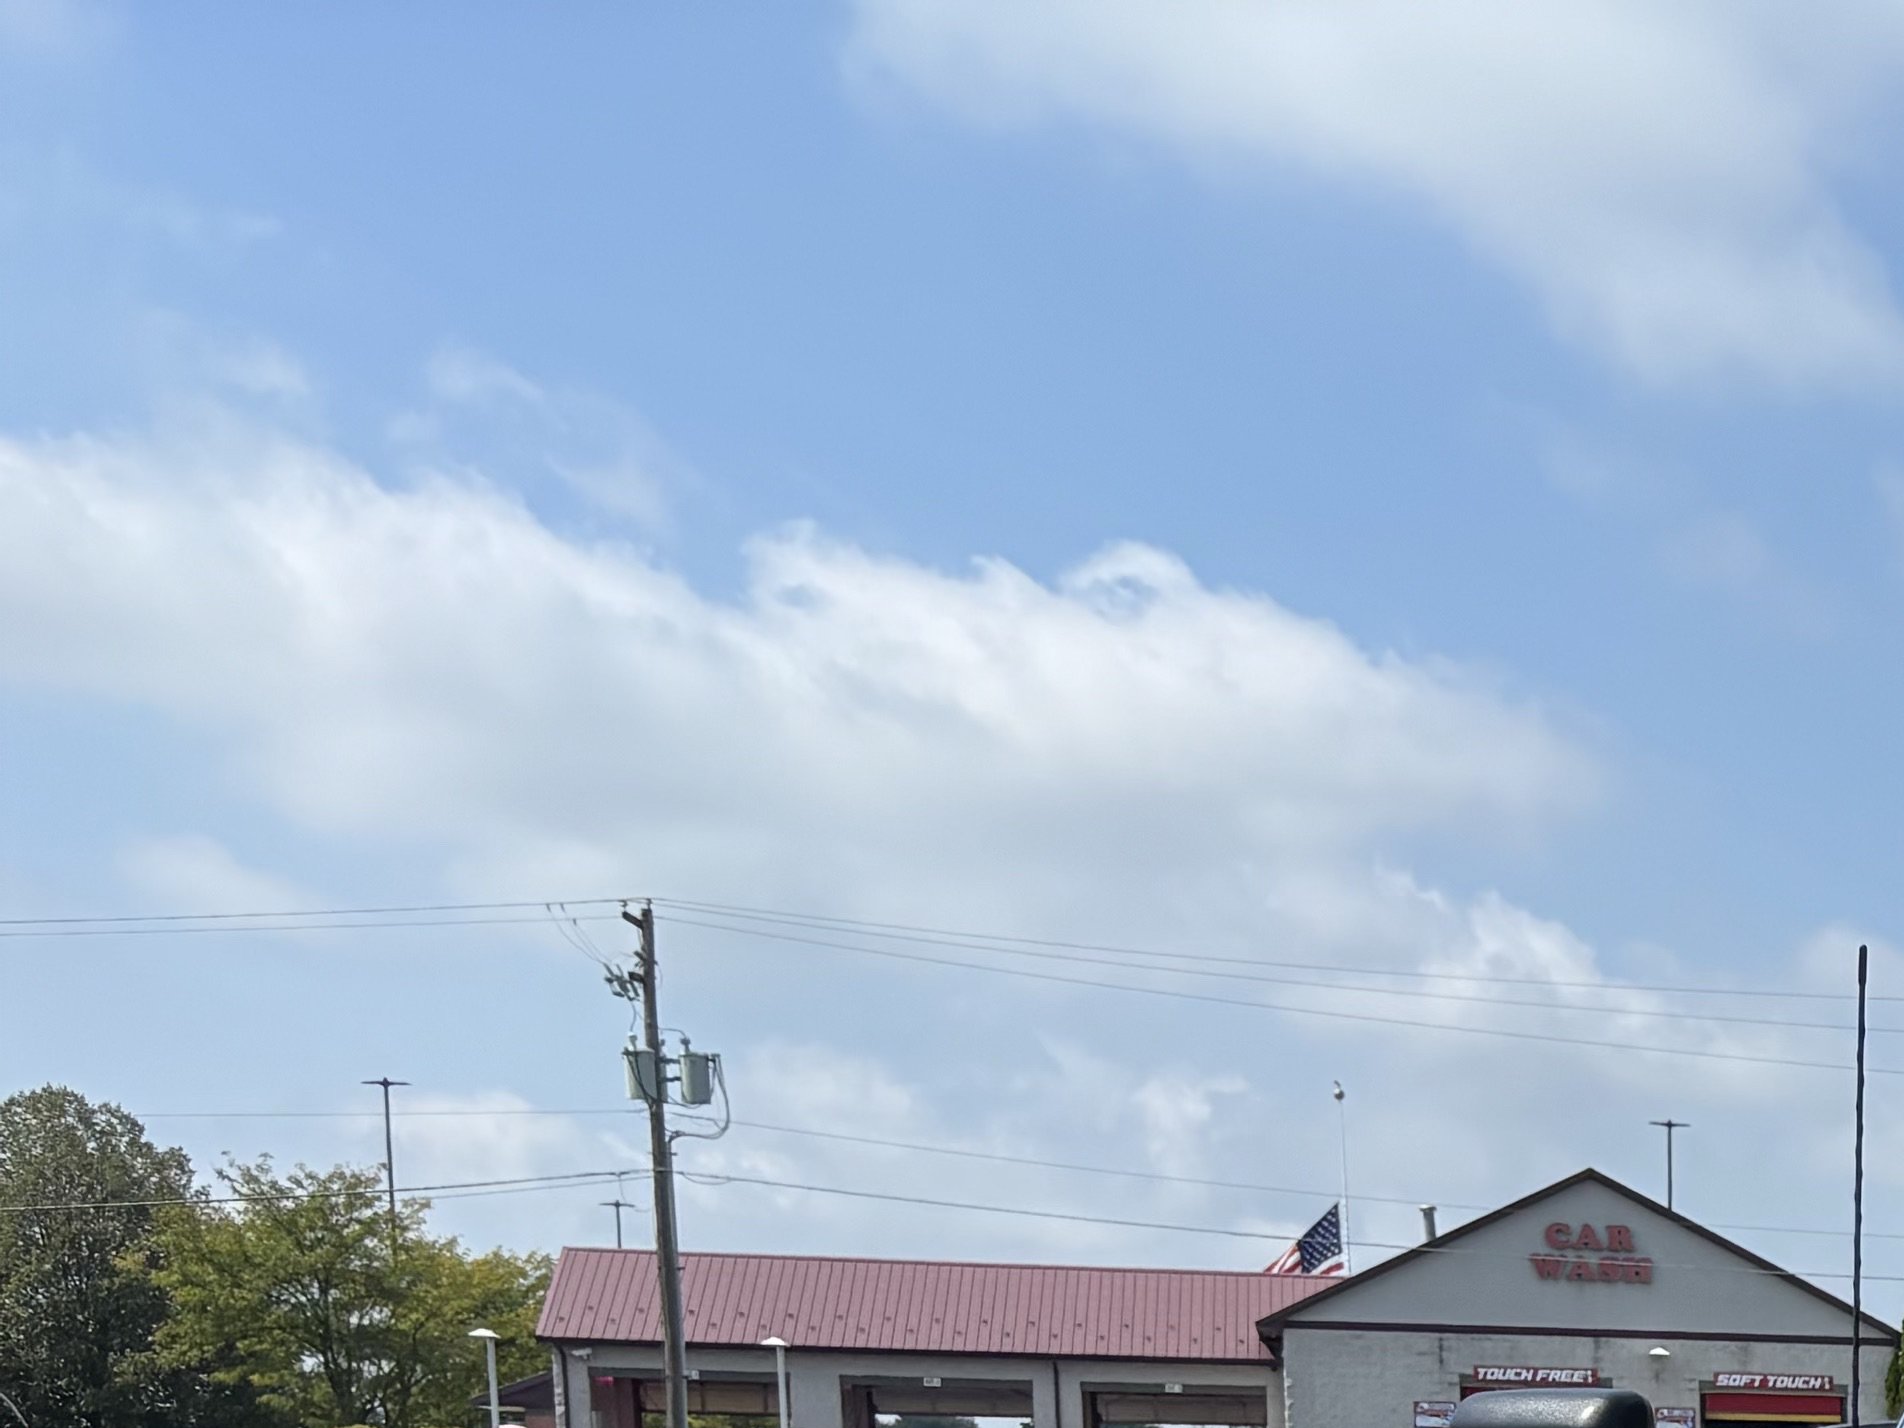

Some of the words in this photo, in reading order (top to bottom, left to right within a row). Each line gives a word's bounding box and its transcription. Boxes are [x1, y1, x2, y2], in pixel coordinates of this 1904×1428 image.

[1545, 1222, 1635, 1252] CAR
[1529, 1252, 1654, 1284] WASH
[1477, 1367, 1534, 1381] TOUCH
[1535, 1369, 1593, 1383] FREE!
[1716, 1374, 1763, 1387] SOFT
[1766, 1374, 1831, 1389] TOUCH!
